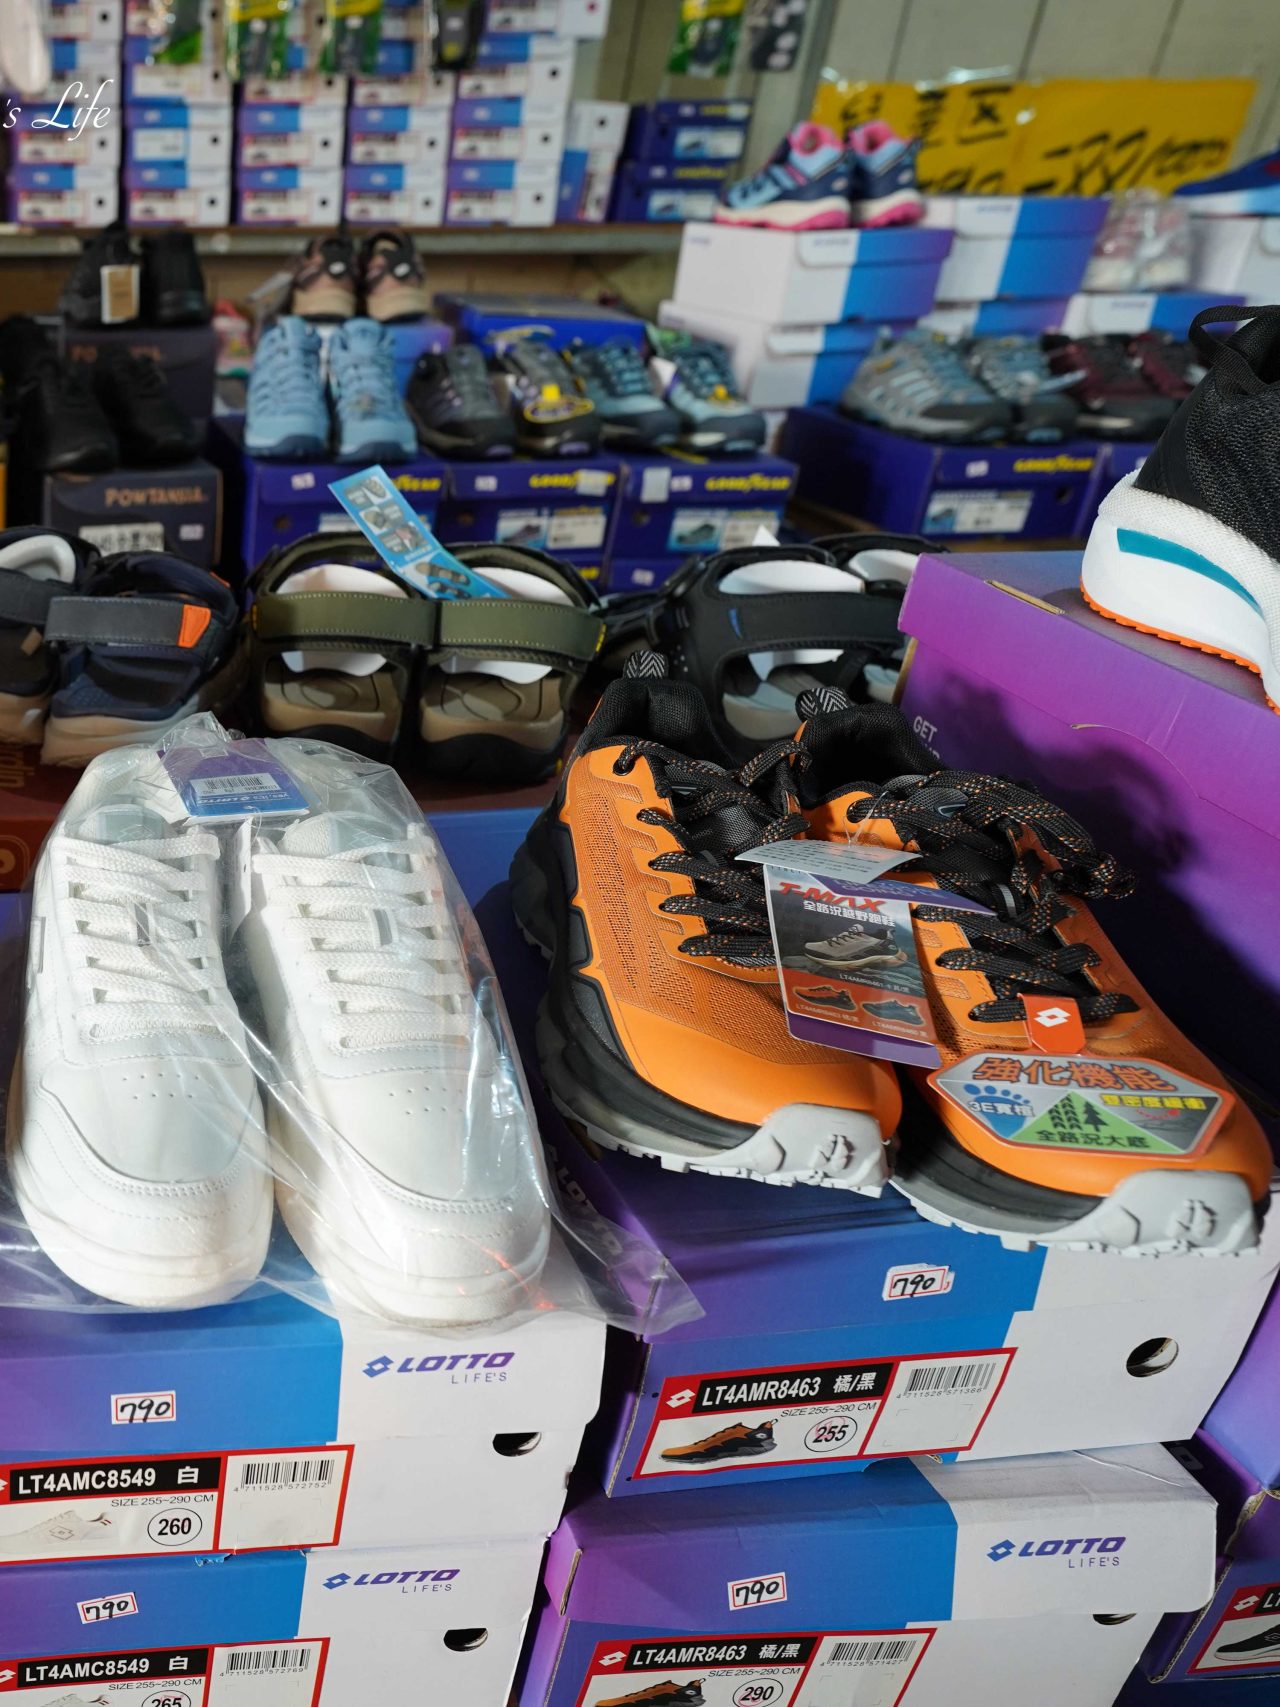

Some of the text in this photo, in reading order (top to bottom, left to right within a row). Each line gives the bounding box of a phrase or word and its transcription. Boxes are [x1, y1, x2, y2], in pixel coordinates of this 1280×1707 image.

[914, 715, 937, 742] GET
[973, 1057, 1178, 1091] 強化機能
[893, 1275, 936, 1297] 790
[397, 1352, 515, 1373] LOTTO
[451, 1372, 506, 1384] LIFE'S
[701, 1372, 875, 1406] LT4AMR8463 橘/黑
[120, 1399, 170, 1423] 790
[781, 1408, 806, 1417] SIZE
[858, 1402, 877, 1411] CM
[813, 1424, 847, 1443] 255
[19, 1466, 199, 1495] LT4AMC8549 白
[111, 1498, 139, 1508] SIZE
[194, 1494, 214, 1503] CM
[158, 1518, 192, 1537] 260
[1018, 1537, 1126, 1557] LOTTO
[1068, 1556, 1119, 1568] LIFE'S
[353, 1569, 461, 1586] LOTTO
[402, 1583, 452, 1593] LIFE'S
[735, 1581, 779, 1605] 790
[85, 1600, 129, 1620] 790
[633, 1643, 802, 1666] LT4AMR8463 橘/黑
[25, 1656, 188, 1682] LT4AMC8549 白
[708, 1669, 733, 1677] SIZE
[783, 1667, 801, 1676] CM
[109, 1683, 134, 1691] SIZE
[183, 1678, 202, 1687] CM
[741, 1686, 774, 1702] 290
[151, 1696, 182, 1707] 265
